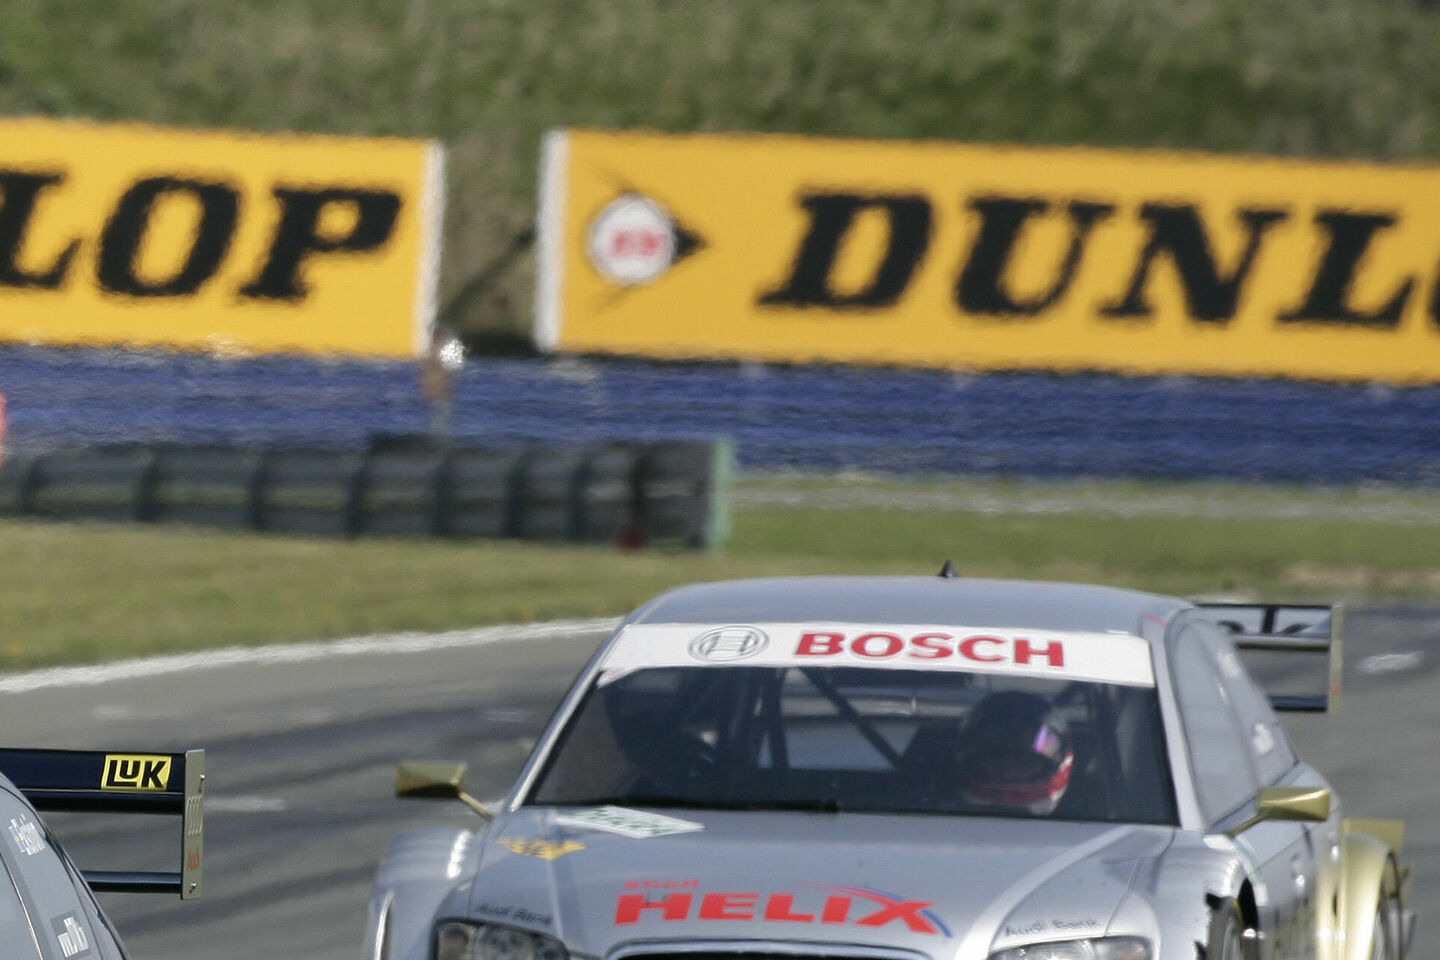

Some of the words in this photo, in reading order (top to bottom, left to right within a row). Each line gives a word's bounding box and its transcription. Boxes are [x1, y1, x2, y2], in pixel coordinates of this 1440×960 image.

[756, 190, 1440, 329] DUNL
[794, 632, 1065, 667] BOSCH
[614, 892, 940, 935] HELIX
